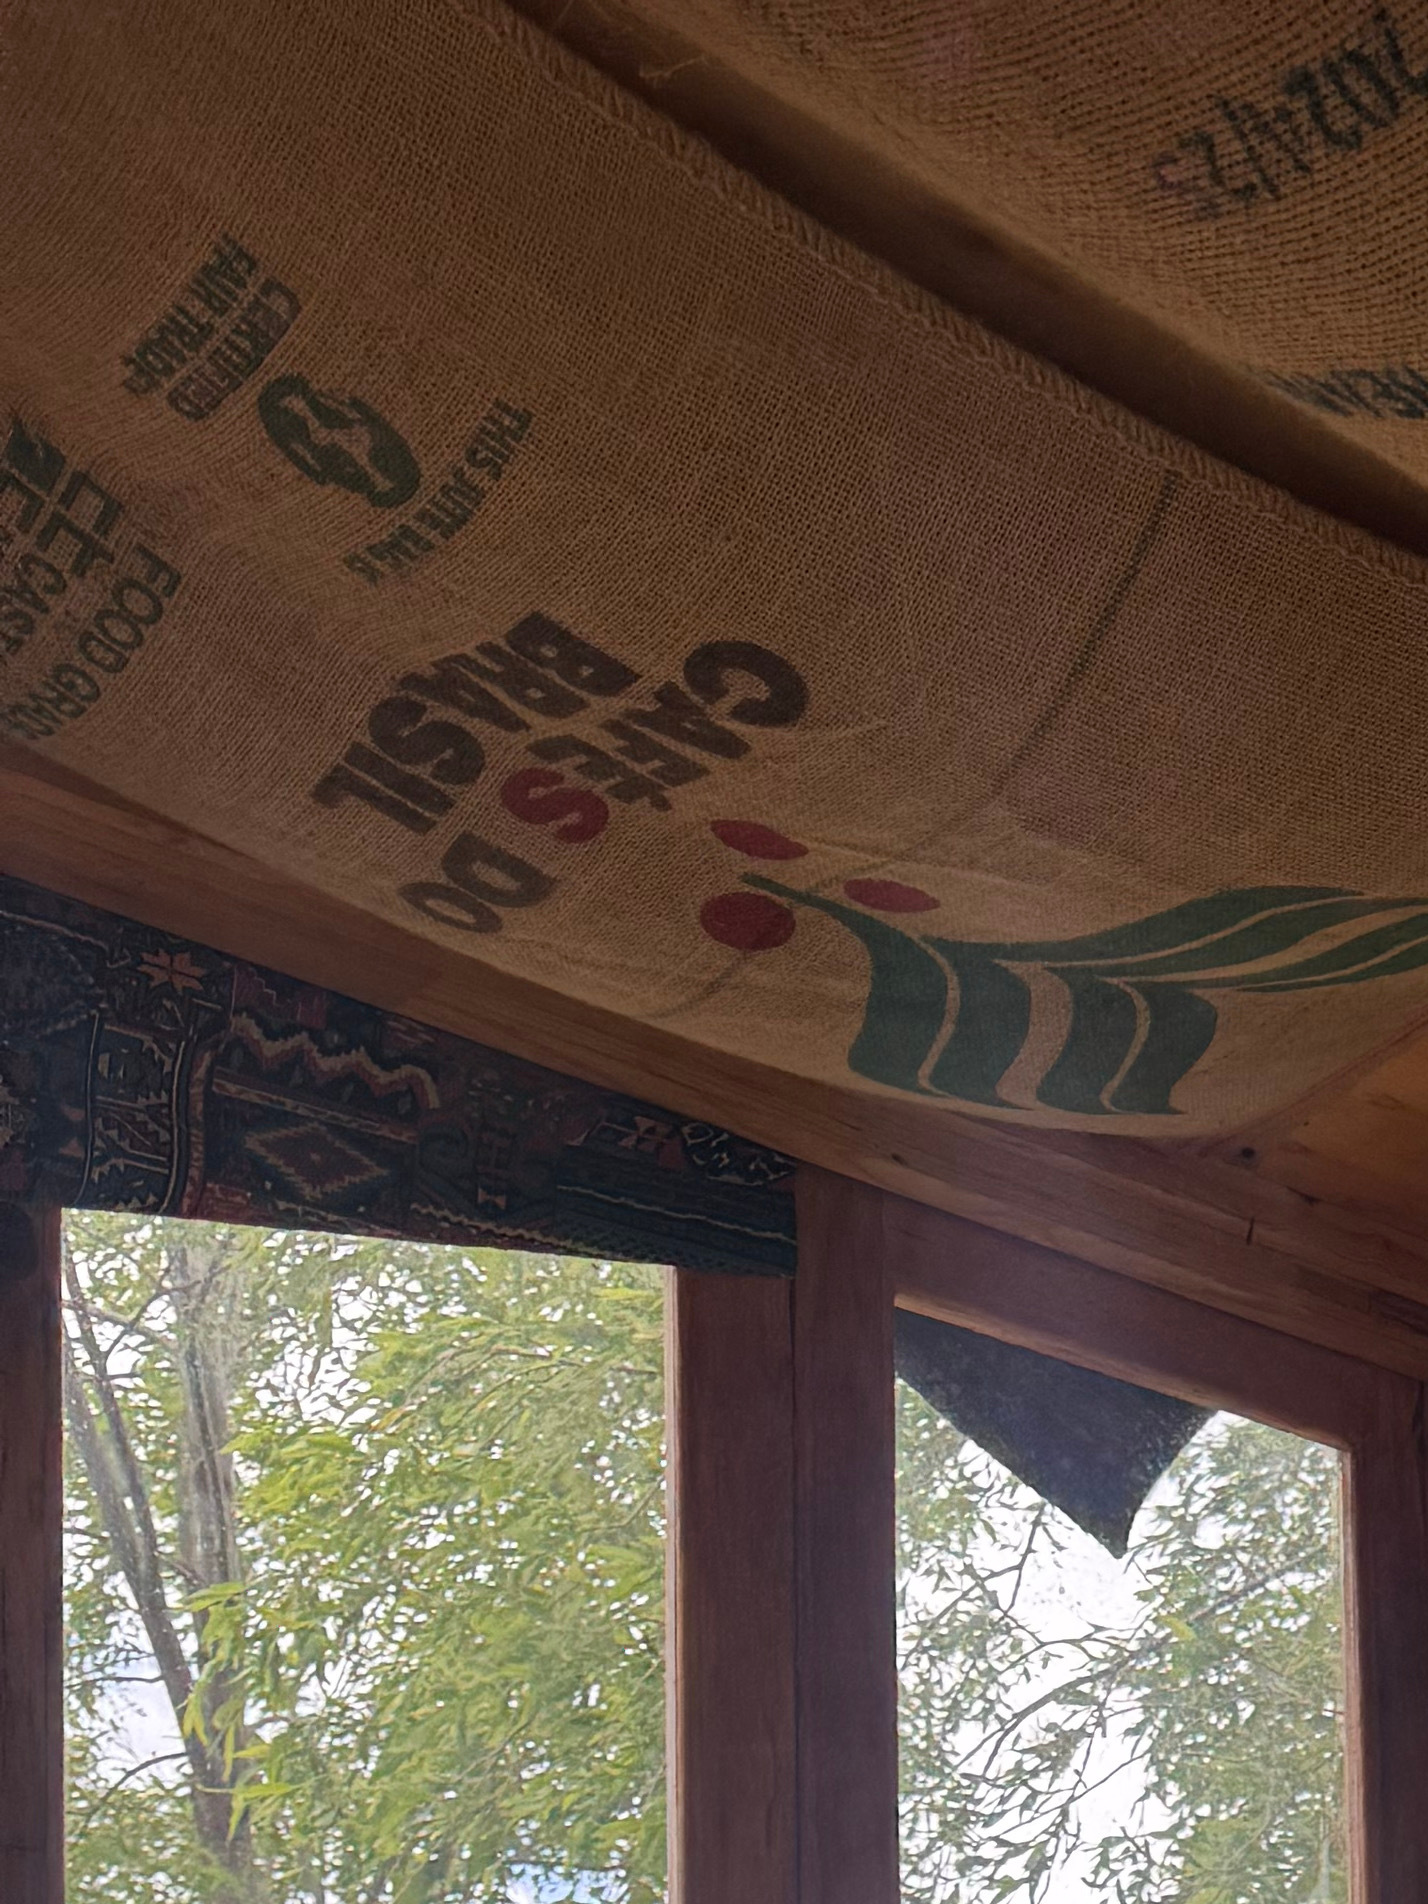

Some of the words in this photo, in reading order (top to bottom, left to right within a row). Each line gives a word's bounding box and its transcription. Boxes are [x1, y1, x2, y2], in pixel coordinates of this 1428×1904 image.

[464, 400, 533, 480] THIS
[77, 541, 182, 674] FOOD
[313, 610, 642, 835] BRASIL
[400, 830, 558, 933] DO
